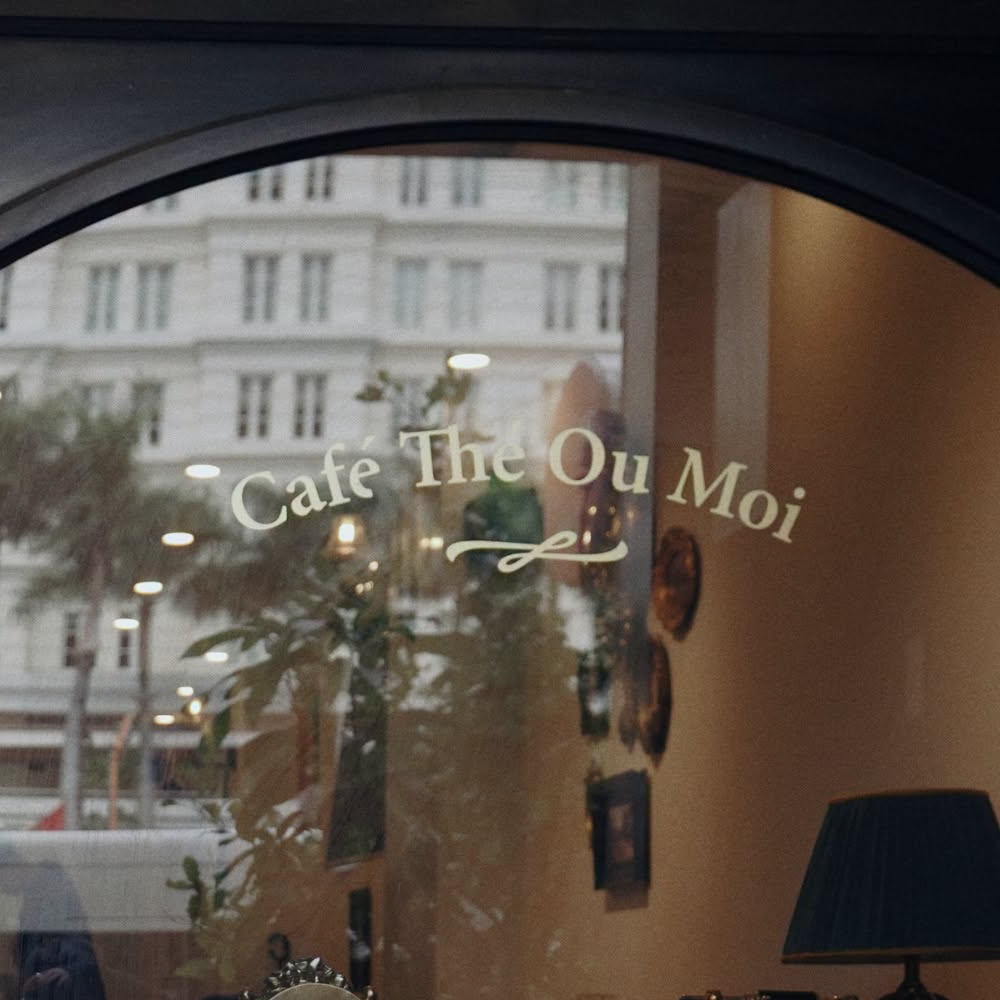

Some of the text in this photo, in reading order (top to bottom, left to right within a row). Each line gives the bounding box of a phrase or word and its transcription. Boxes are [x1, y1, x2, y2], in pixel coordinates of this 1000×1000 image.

[231, 434, 380, 531] Café
[548, 427, 650, 494] Ou
[666, 446, 807, 543] Moi
